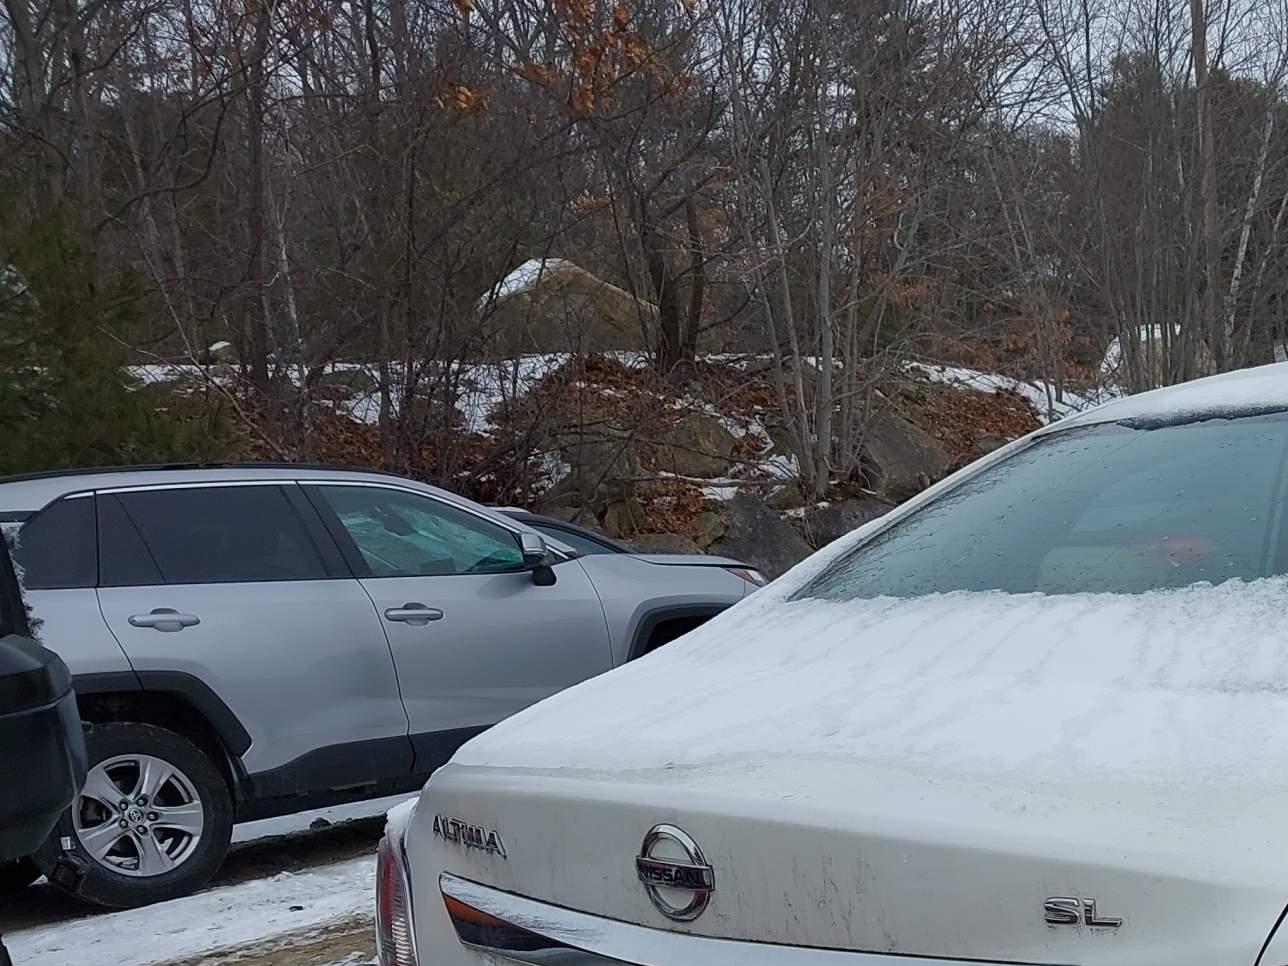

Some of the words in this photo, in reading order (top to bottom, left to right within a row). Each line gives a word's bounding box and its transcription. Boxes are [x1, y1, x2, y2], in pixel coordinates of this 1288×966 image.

[431, 814, 507, 860] ALTIMA
[639, 867, 704, 884] NISSAN
[1043, 896, 1123, 928] SL
